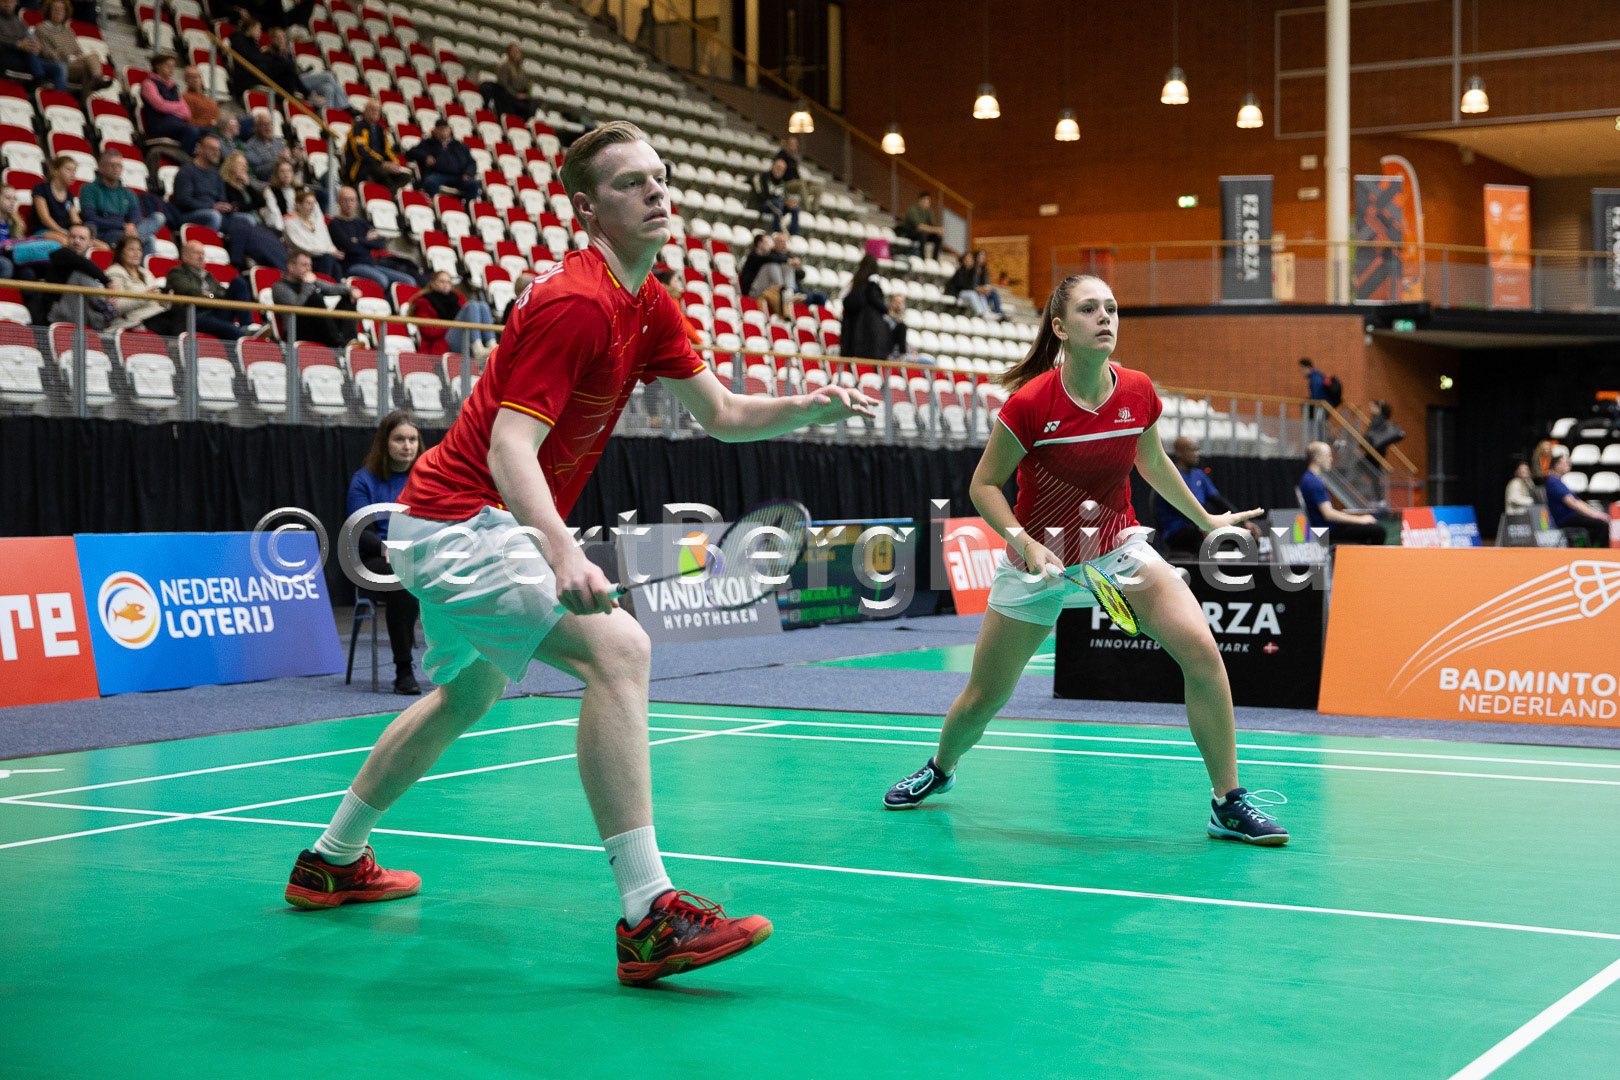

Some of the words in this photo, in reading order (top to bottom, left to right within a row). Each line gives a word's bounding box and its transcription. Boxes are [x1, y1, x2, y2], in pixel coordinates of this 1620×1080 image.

[159, 574, 320, 606] NEDERLANDSE
[165, 605, 275, 639] LOTERIJ
[663, 608, 759, 630] HYPOTHEKEN
[1089, 638, 1162, 650] INNOVATED
[1439, 667, 1620, 697] BADMINTO
[1459, 693, 1617, 719] NEDERLAND
